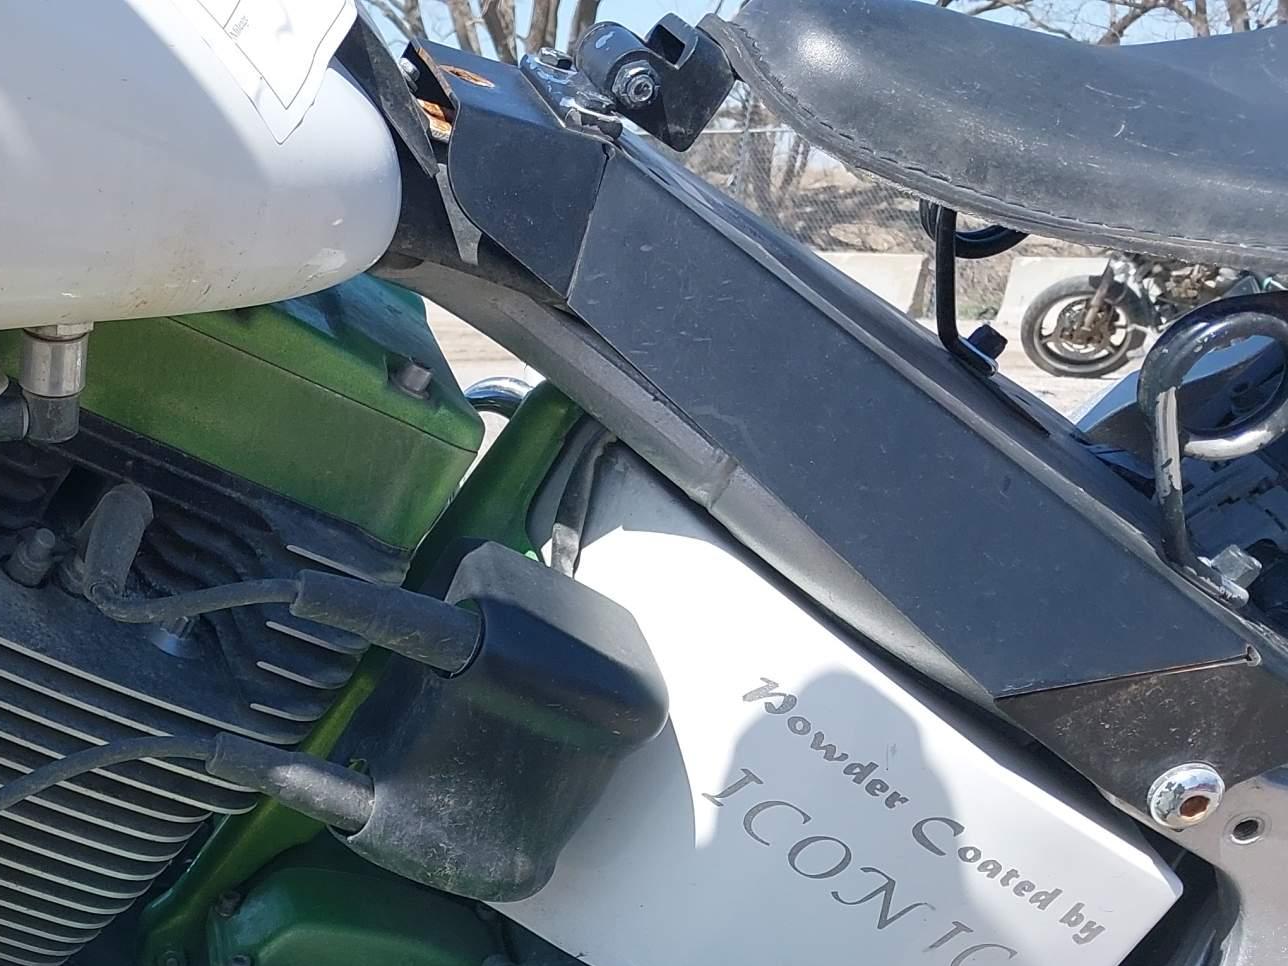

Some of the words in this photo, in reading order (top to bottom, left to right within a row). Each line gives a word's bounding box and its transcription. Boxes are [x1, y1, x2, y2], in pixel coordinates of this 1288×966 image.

[742, 676, 910, 810] Powder
[912, 816, 1063, 911] Coated
[1059, 902, 1105, 945] by
